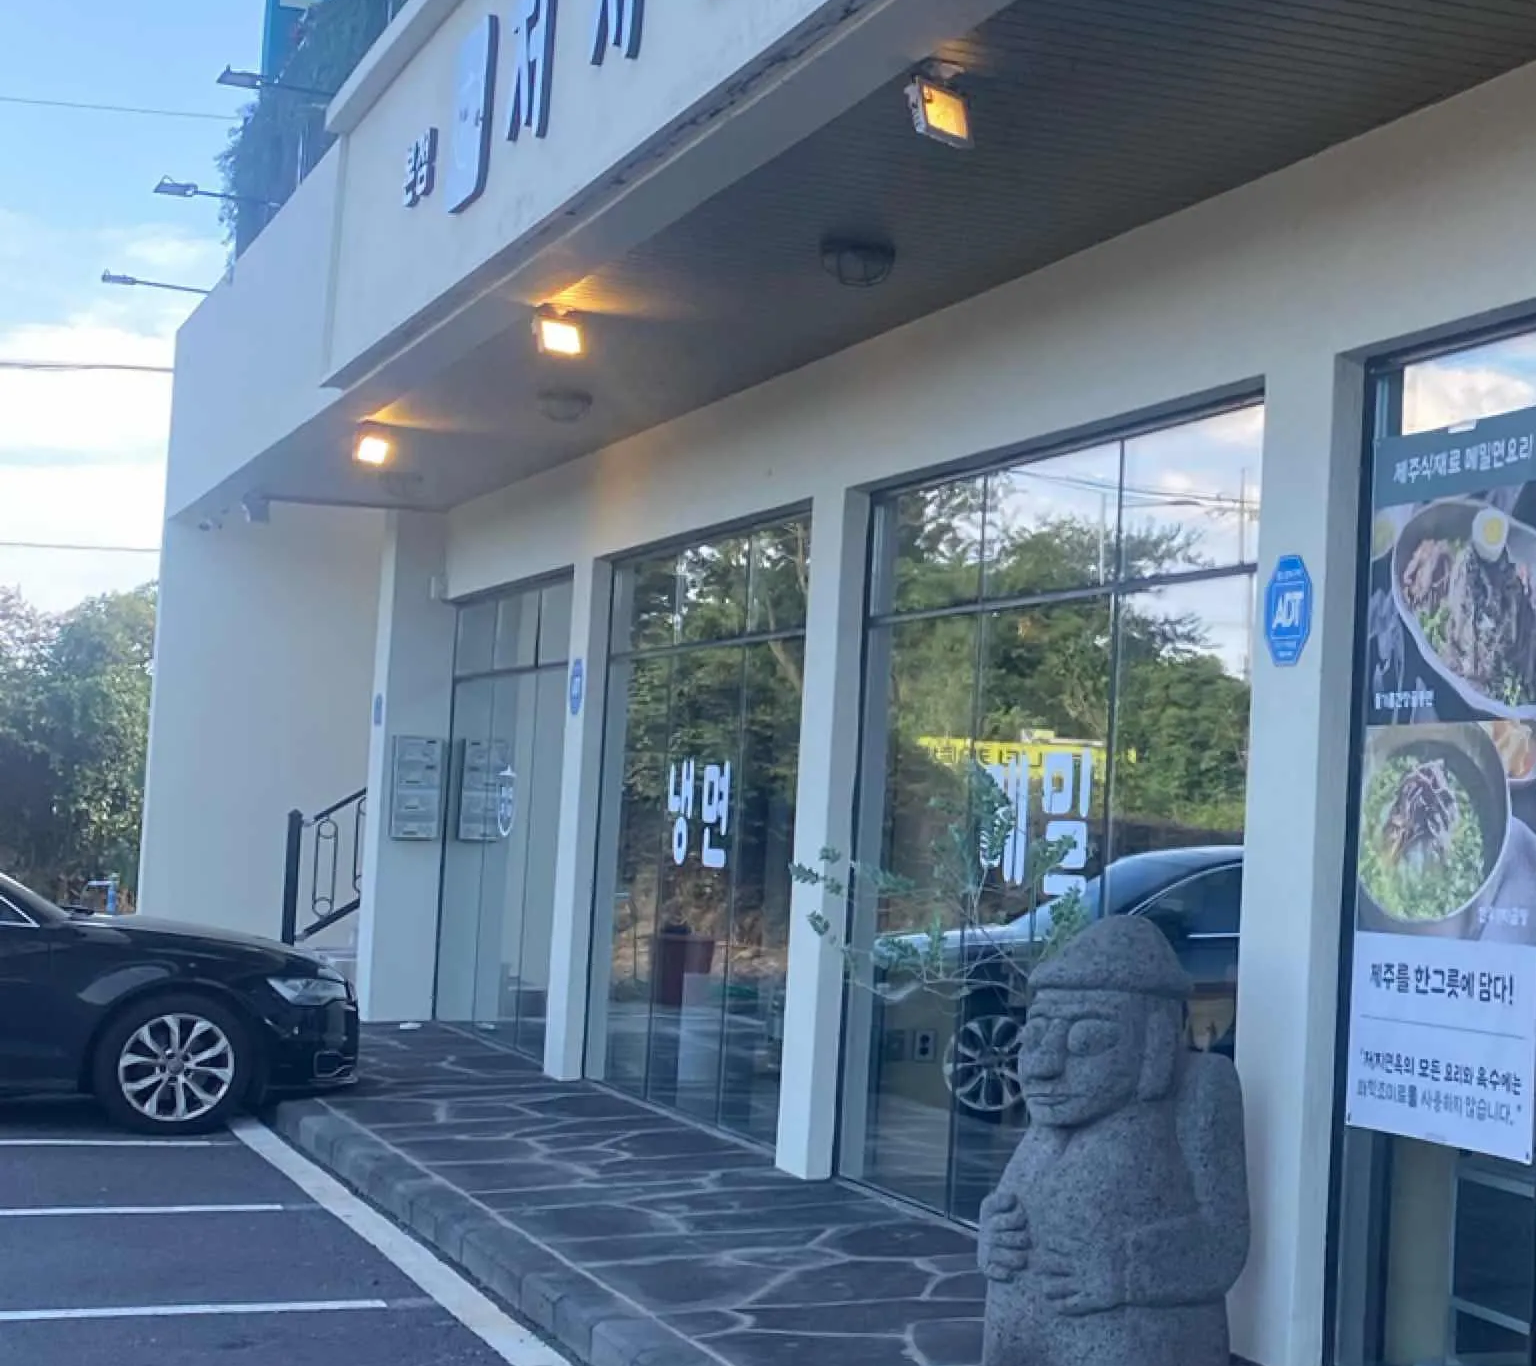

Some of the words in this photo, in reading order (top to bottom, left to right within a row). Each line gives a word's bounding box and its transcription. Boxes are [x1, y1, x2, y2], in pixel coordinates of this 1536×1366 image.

[1272, 591, 1304, 627] ADT
[668, 756, 731, 868] 냉면
[1370, 962, 1410, 993] 제주를
[1415, 965, 1475, 999] 한그릇에
[1479, 972, 1514, 1005] 담다!
[1418, 1058, 1441, 1081] 모든
